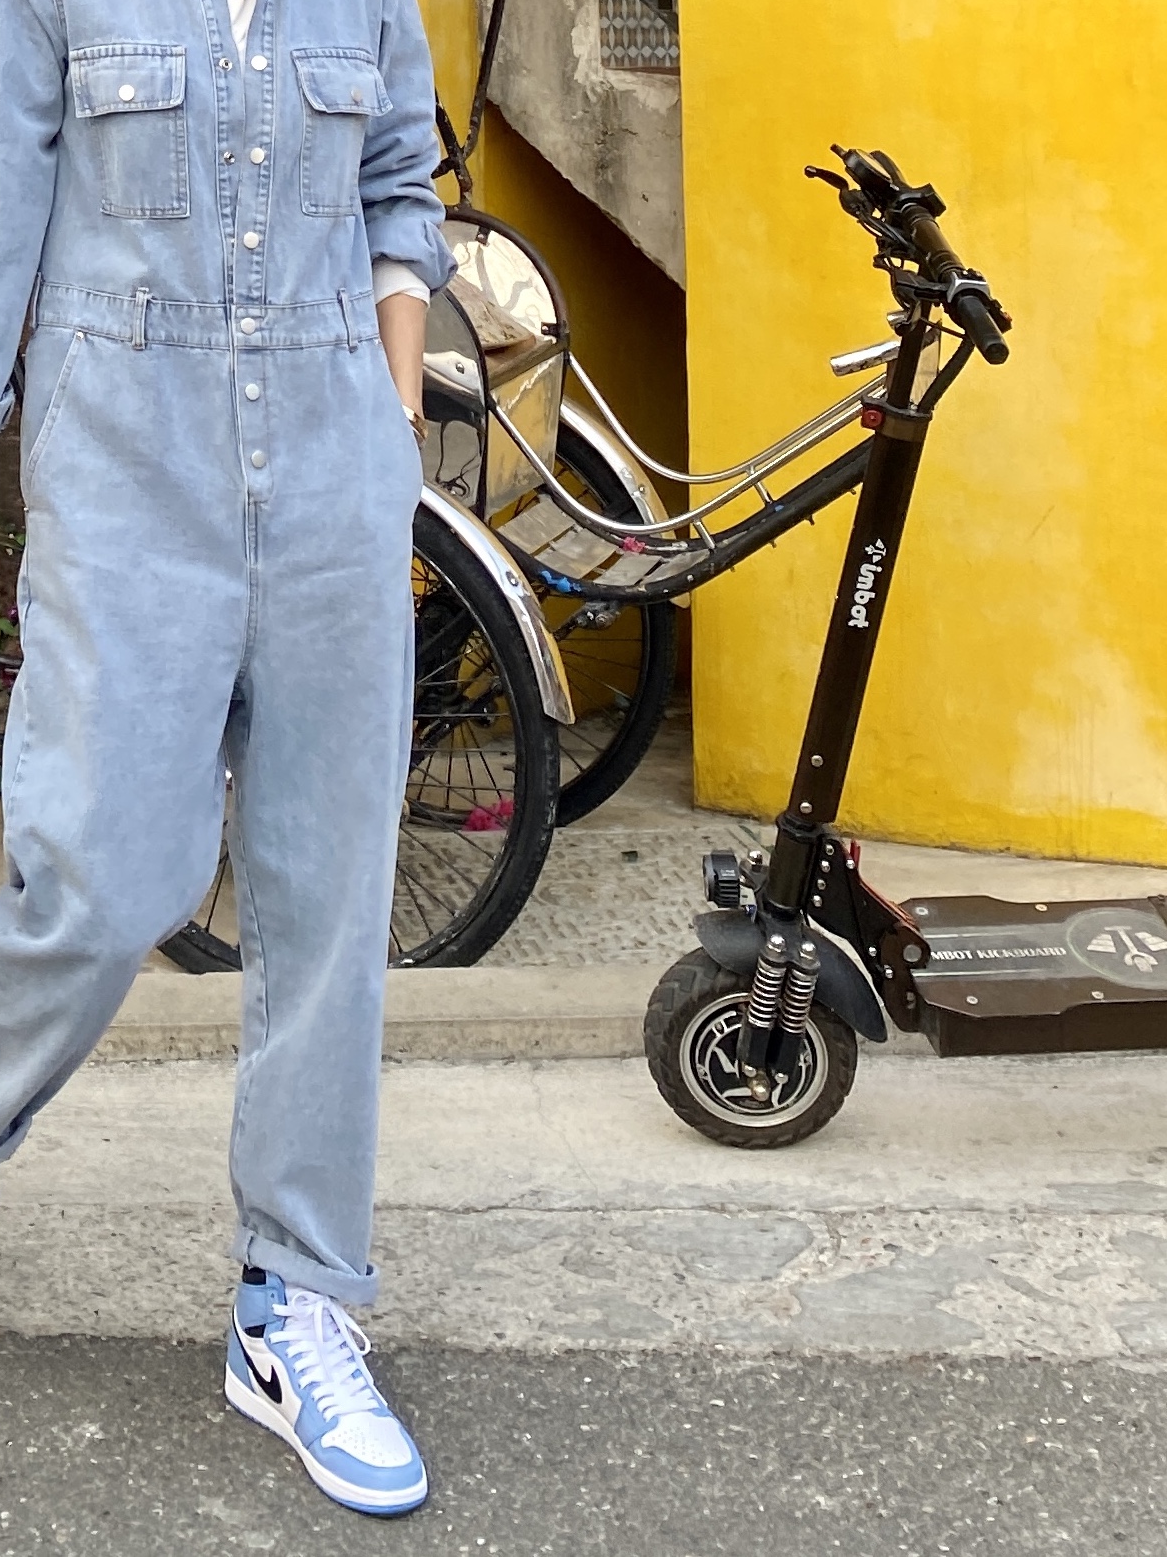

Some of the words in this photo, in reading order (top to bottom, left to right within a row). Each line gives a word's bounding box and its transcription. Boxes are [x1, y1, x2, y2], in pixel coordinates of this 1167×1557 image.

[847, 562, 883, 629] imbot
[930, 950, 973, 961] MBOT
[976, 946, 1067, 960] KICKBOARD
